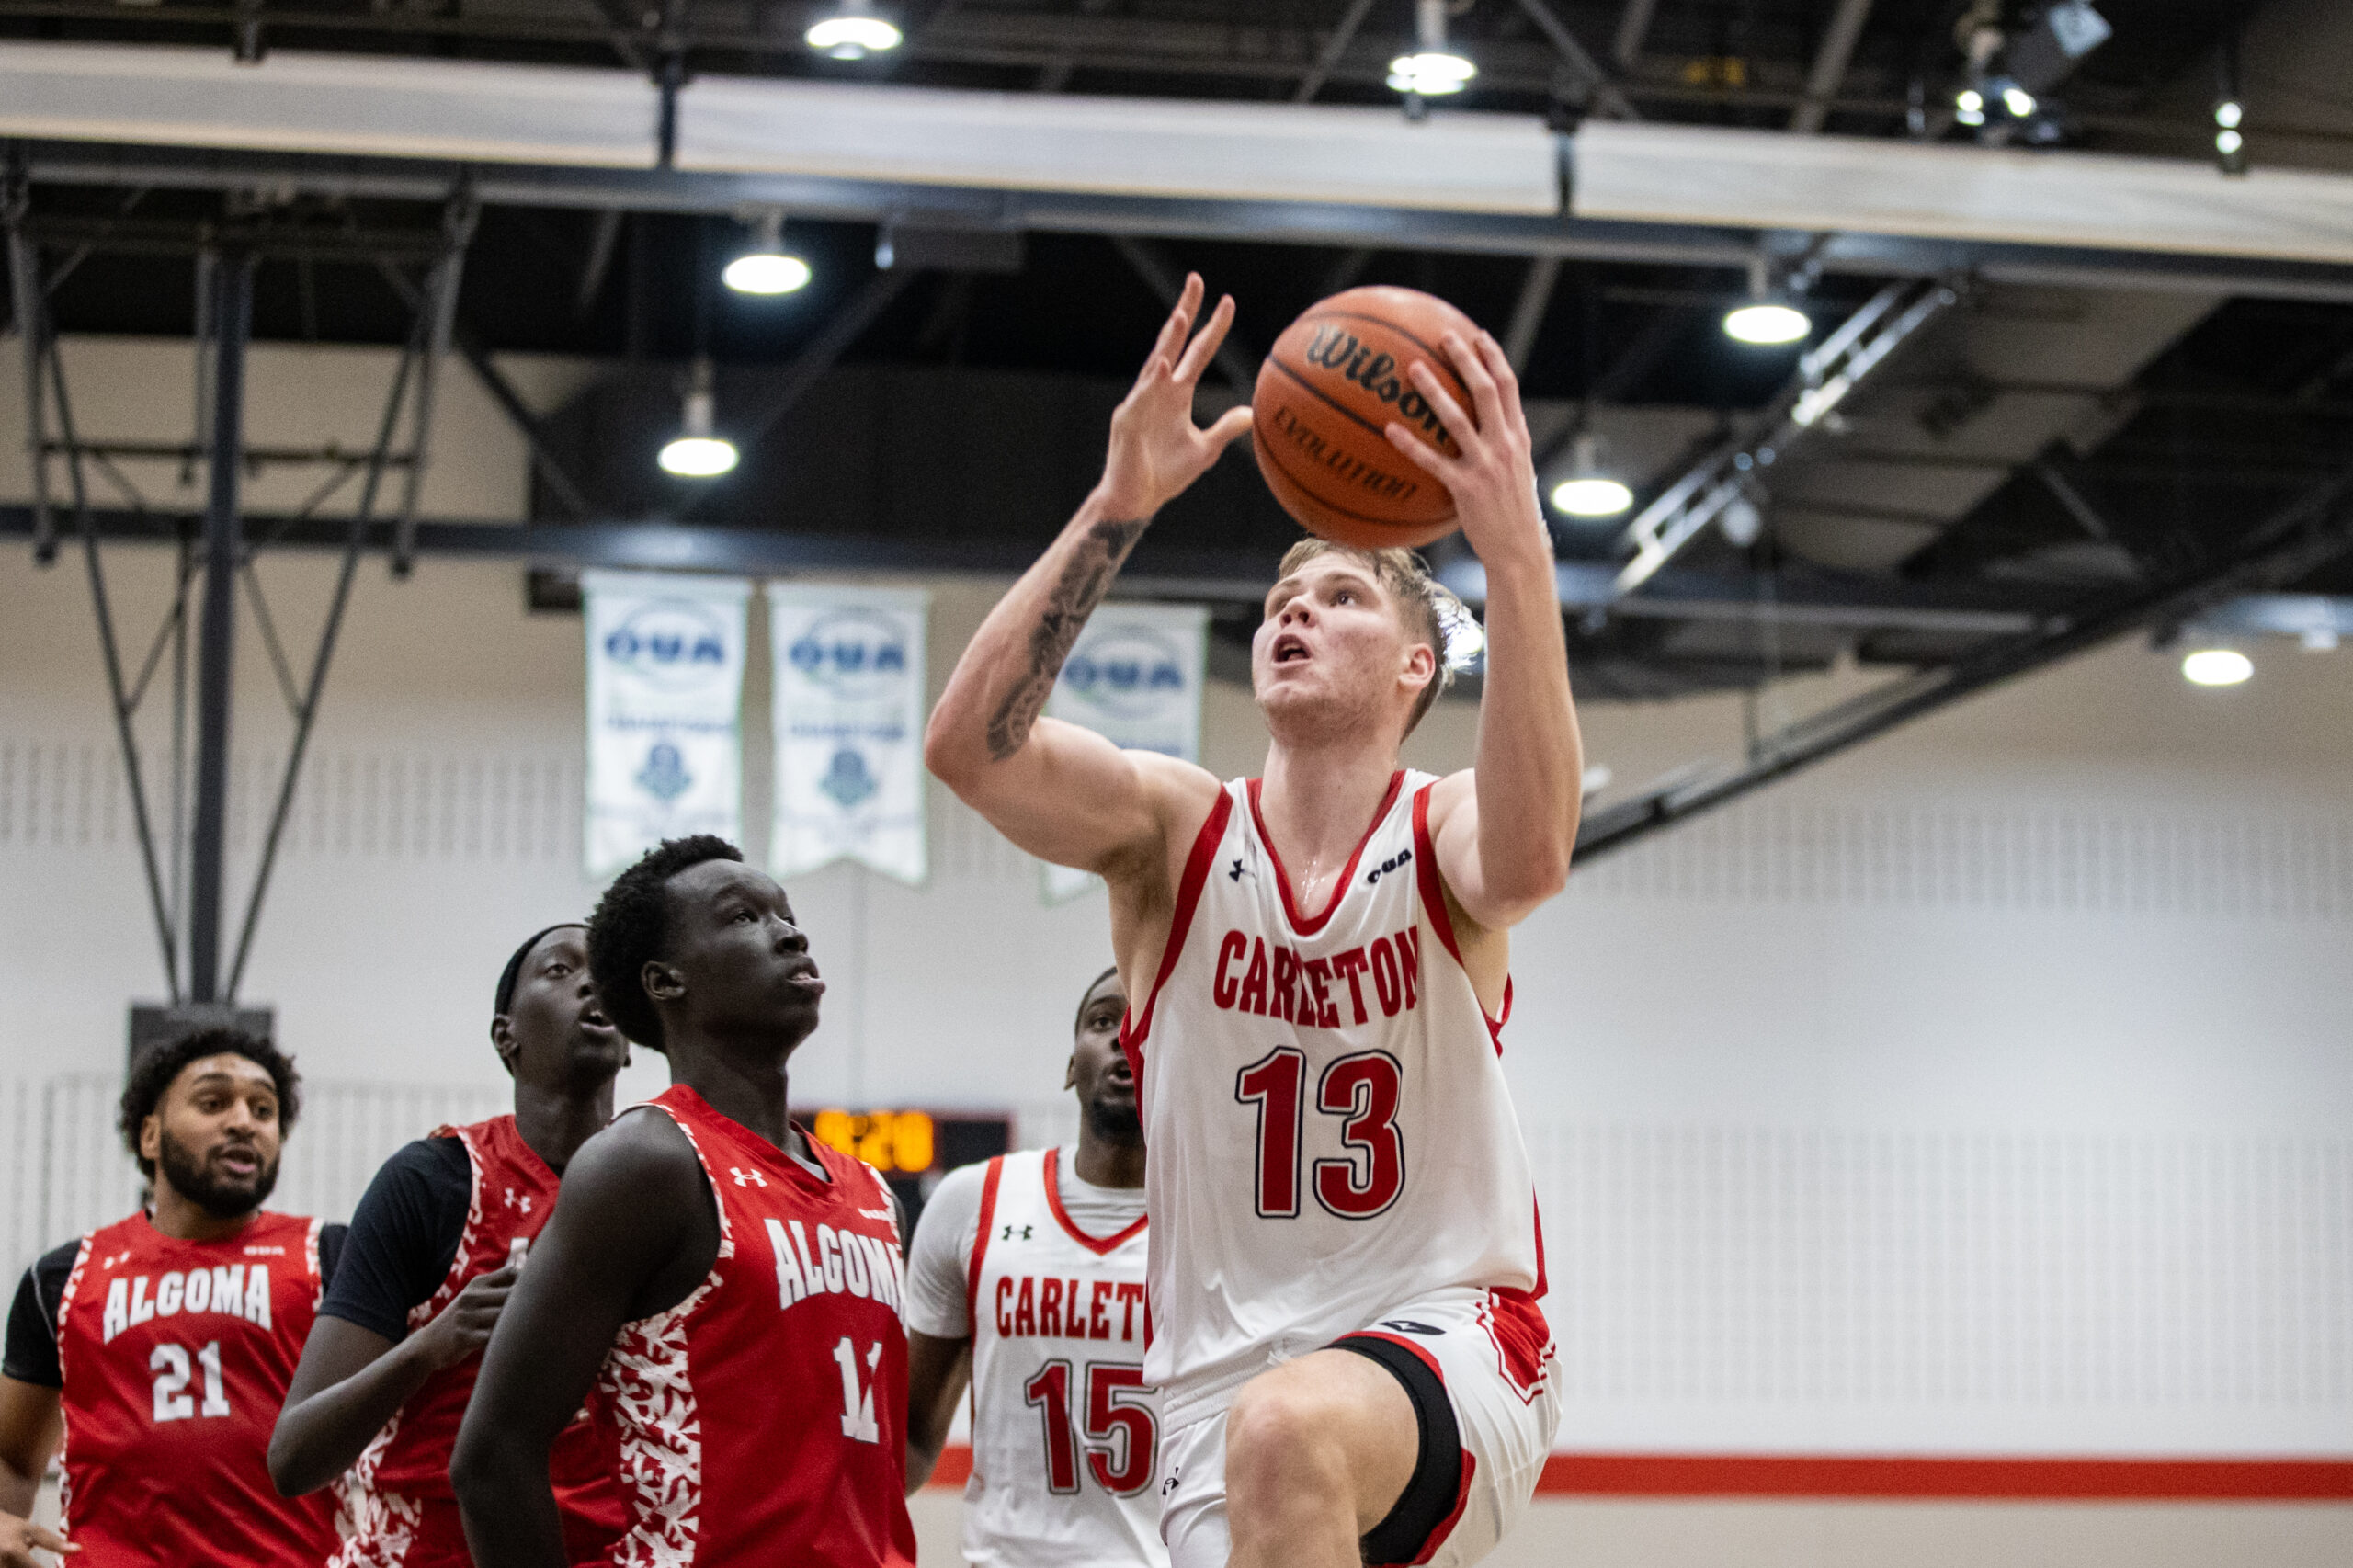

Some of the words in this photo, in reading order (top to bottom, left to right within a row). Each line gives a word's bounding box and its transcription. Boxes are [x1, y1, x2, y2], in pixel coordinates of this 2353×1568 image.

[1307, 324, 1450, 444] Wilson
[1367, 848, 1412, 884] OUA
[1213, 925, 1418, 1028] CARLETON
[1235, 1045, 1405, 1220] 13
[103, 1264, 272, 1346] ALGOMA
[150, 1340, 230, 1422] 21
[833, 1336, 883, 1445] 11
[1024, 1358, 1159, 1499] 15
